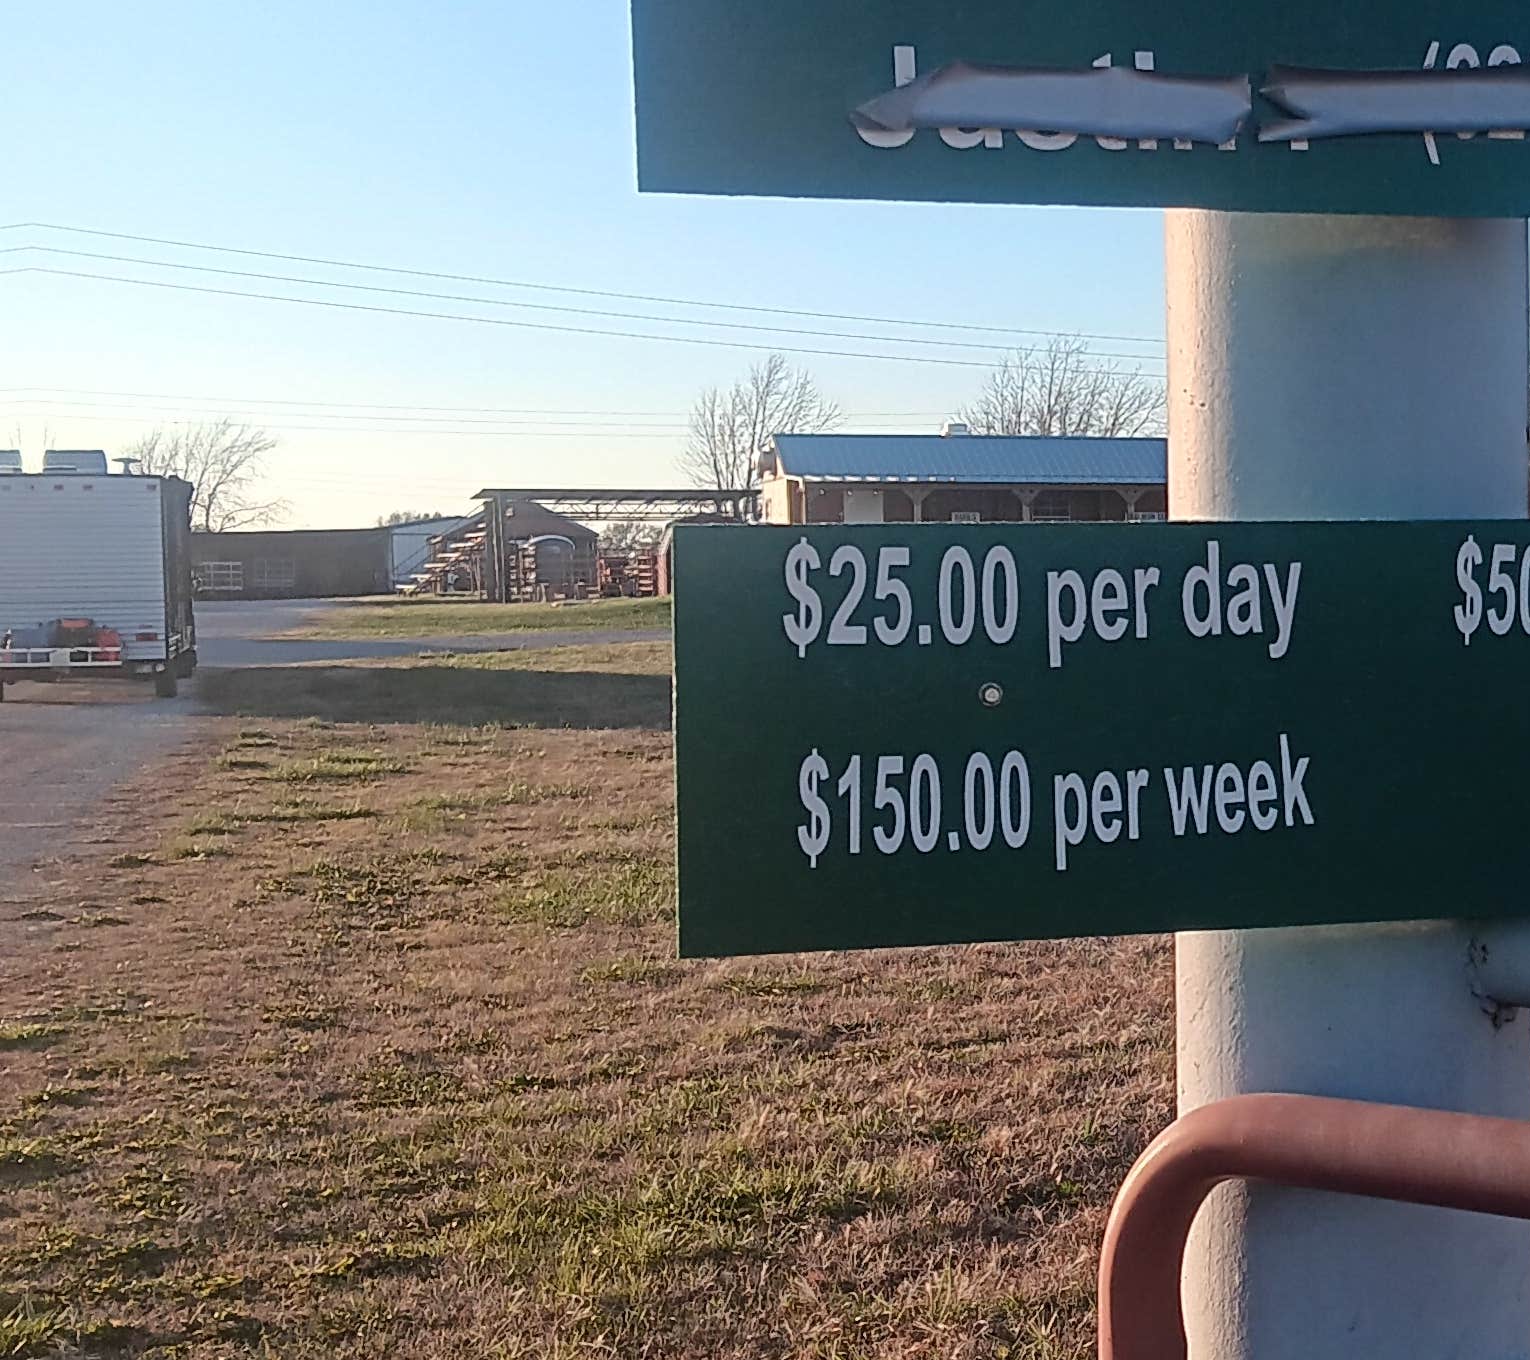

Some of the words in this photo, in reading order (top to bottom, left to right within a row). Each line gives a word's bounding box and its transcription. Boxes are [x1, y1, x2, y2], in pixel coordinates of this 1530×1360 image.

[782, 536, 1019, 658] $25.00
[1046, 566, 1160, 668] per
[1181, 540, 1302, 659] day
[797, 747, 1031, 869] $150.00
[1054, 768, 1150, 871] per
[1163, 733, 1315, 836] week
